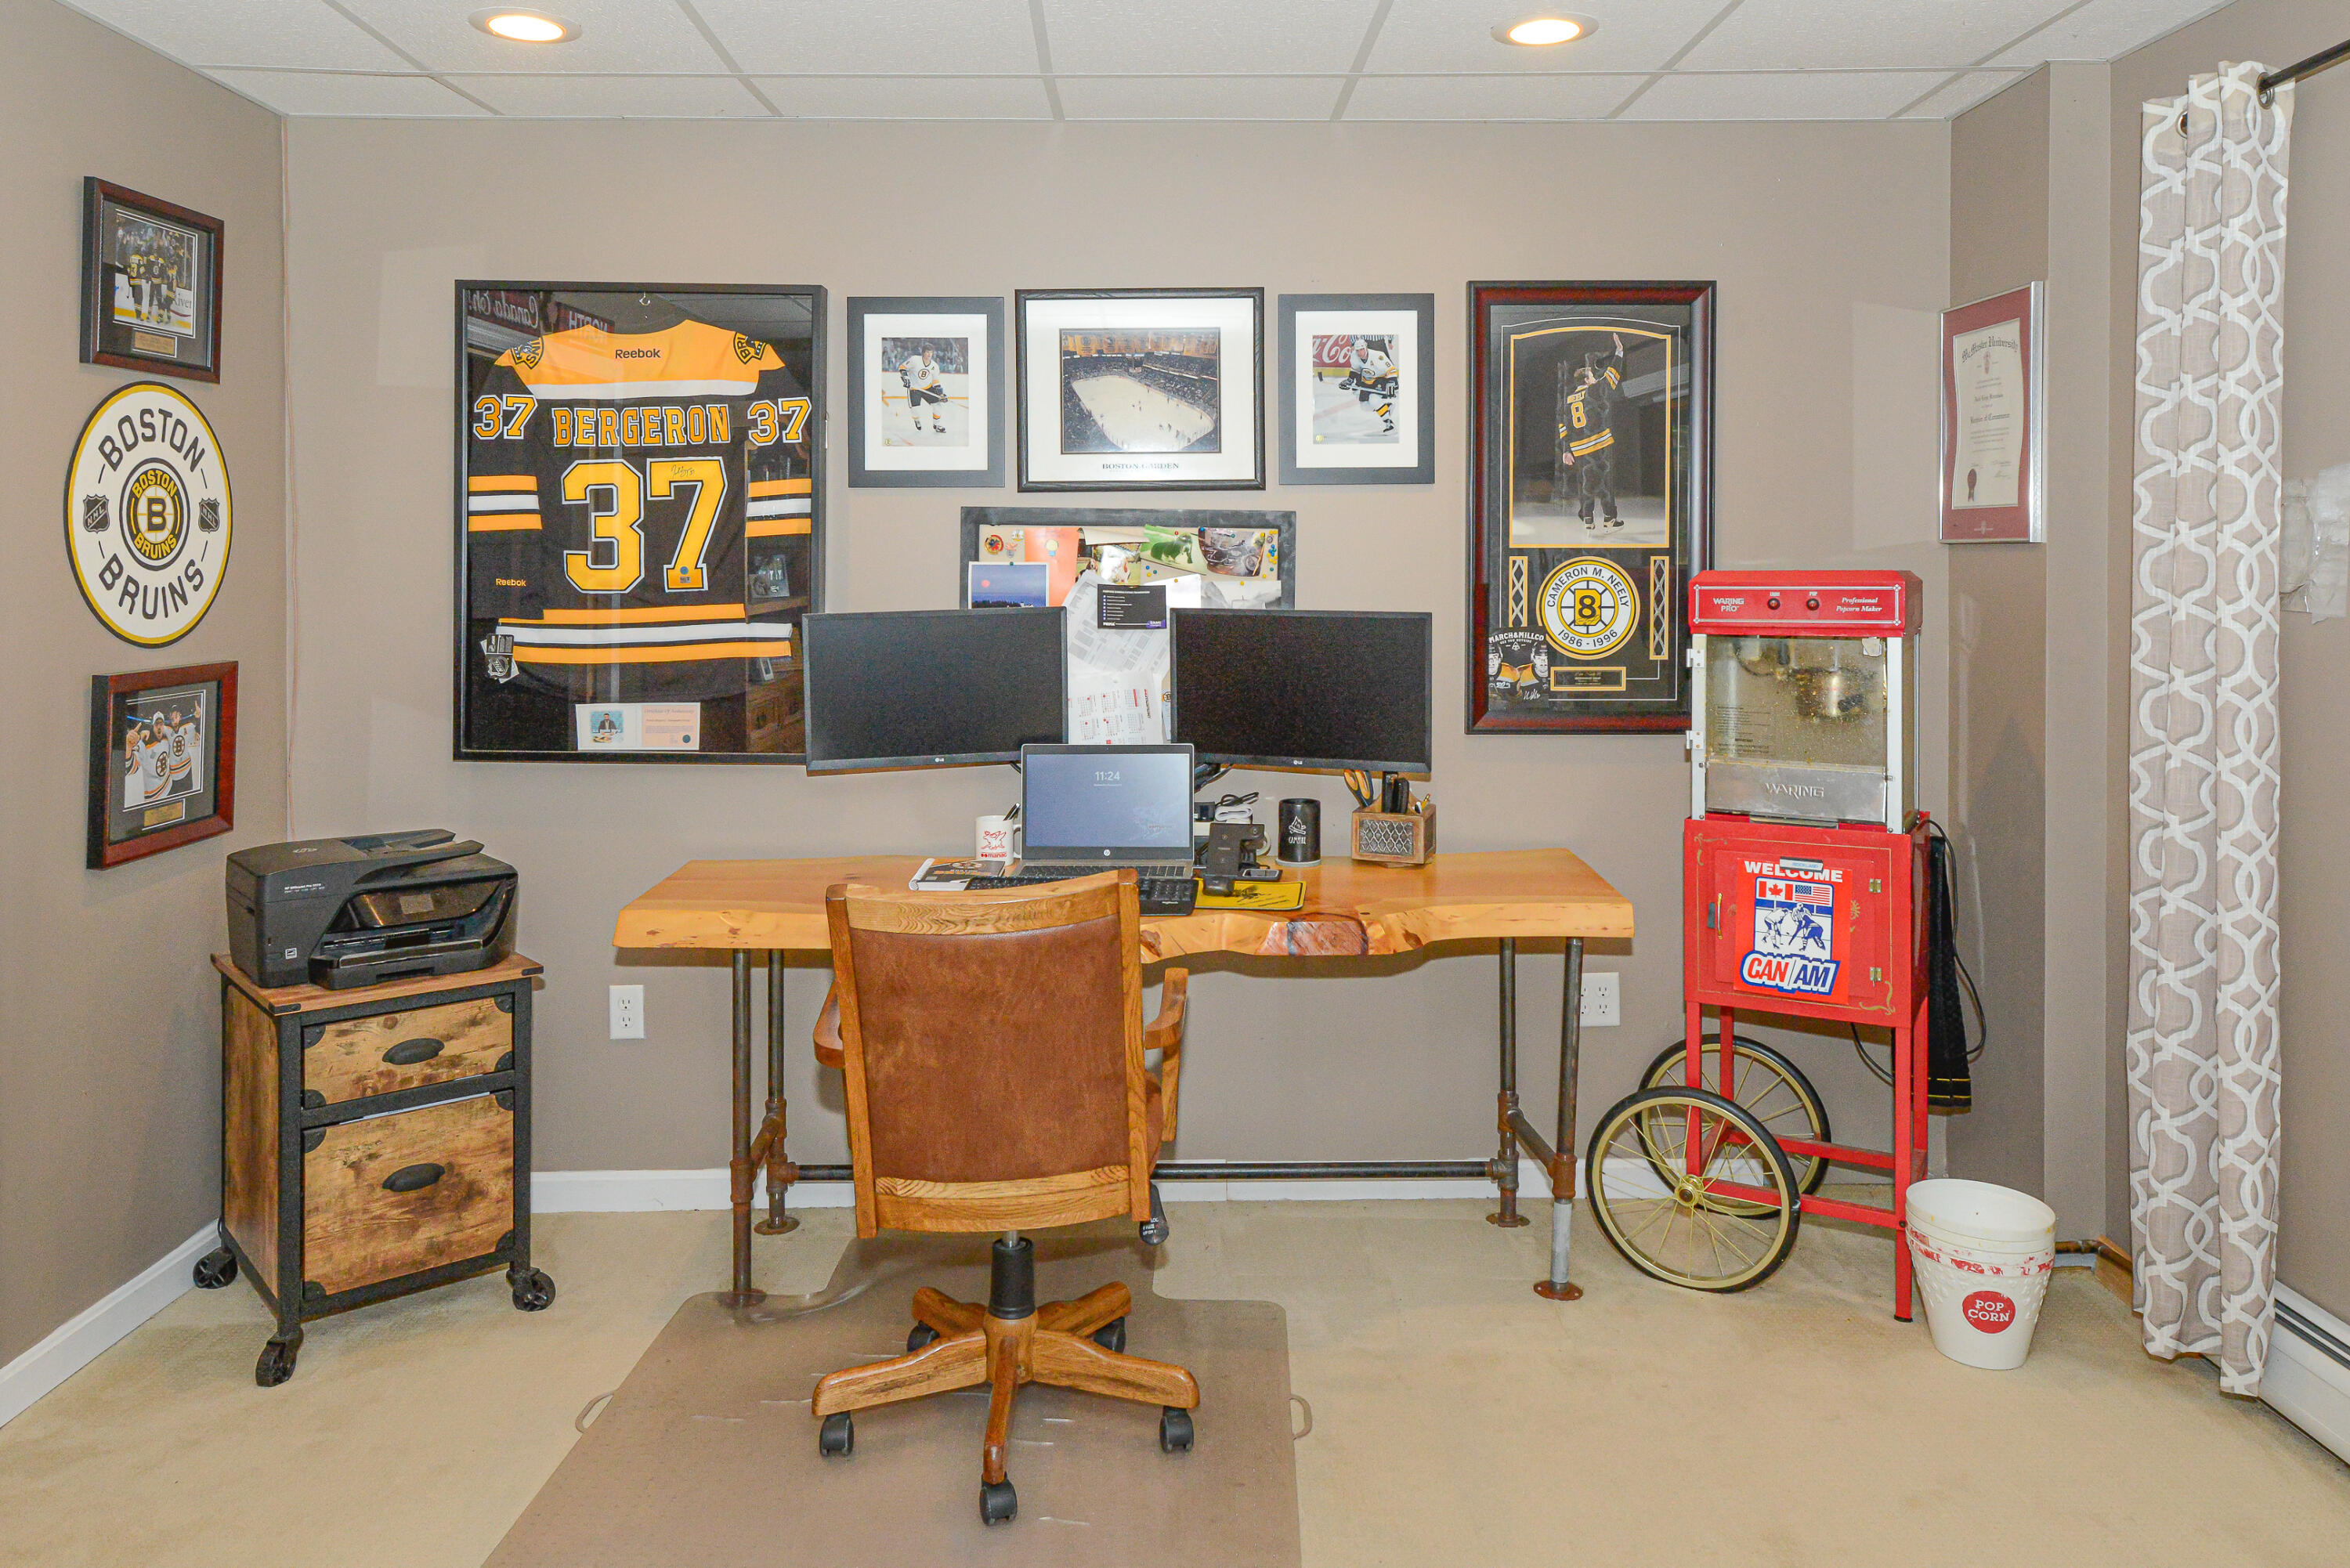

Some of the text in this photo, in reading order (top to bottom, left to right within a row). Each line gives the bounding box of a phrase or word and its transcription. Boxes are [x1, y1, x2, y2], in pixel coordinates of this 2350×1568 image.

[615, 349, 661, 359] Reebok
[1988, 335, 2019, 353] University
[473, 394, 539, 439] 37
[552, 404, 732, 447] BERGERON
[747, 396, 812, 446] 37
[1571, 401, 1587, 428] 8
[98, 408, 206, 472] BOSTON
[132, 470, 178, 498] BOSTON
[87, 505, 105, 526] NHL
[146, 497, 167, 533] B
[201, 507, 218, 526] NHL
[561, 457, 728, 594] 37
[134, 533, 178, 559] BRUINS
[98, 552, 204, 620] BRUINS
[495, 578, 526, 587] Reebok
[1547, 566, 1630, 608] CAMERON M. NEELY
[1578, 594, 1597, 619] 8
[1842, 597, 1879, 605] Professional
[1558, 629, 1583, 648] 1986
[1593, 629, 1618, 648] 1996
[1094, 771, 1121, 781] 11:24
[1765, 783, 1825, 800] WARING
[1744, 860, 1843, 883] WELCOME
[1968, 1309, 2010, 1322] CORN
[1975, 1299, 2005, 1311] POP
